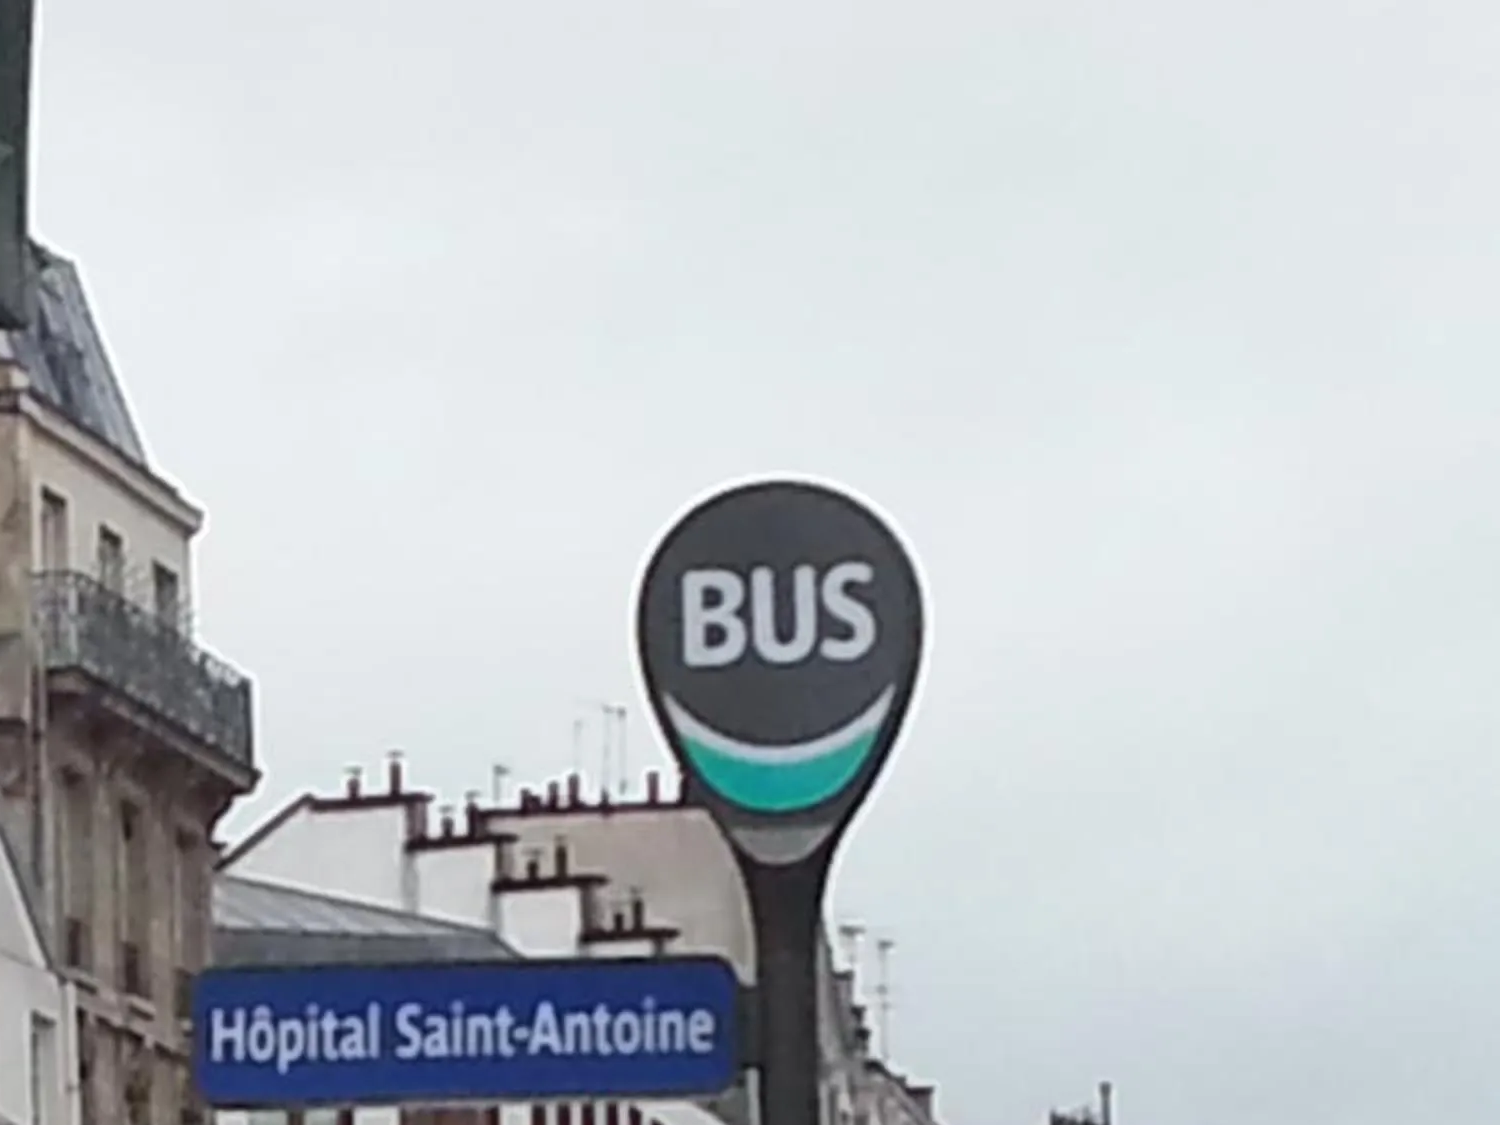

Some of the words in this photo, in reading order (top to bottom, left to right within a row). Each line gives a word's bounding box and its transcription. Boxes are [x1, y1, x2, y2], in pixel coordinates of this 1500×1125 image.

[681, 562, 877, 667] BUS
[211, 1000, 381, 1075] Hôpital
[395, 996, 715, 1060] Saint-Antoine
